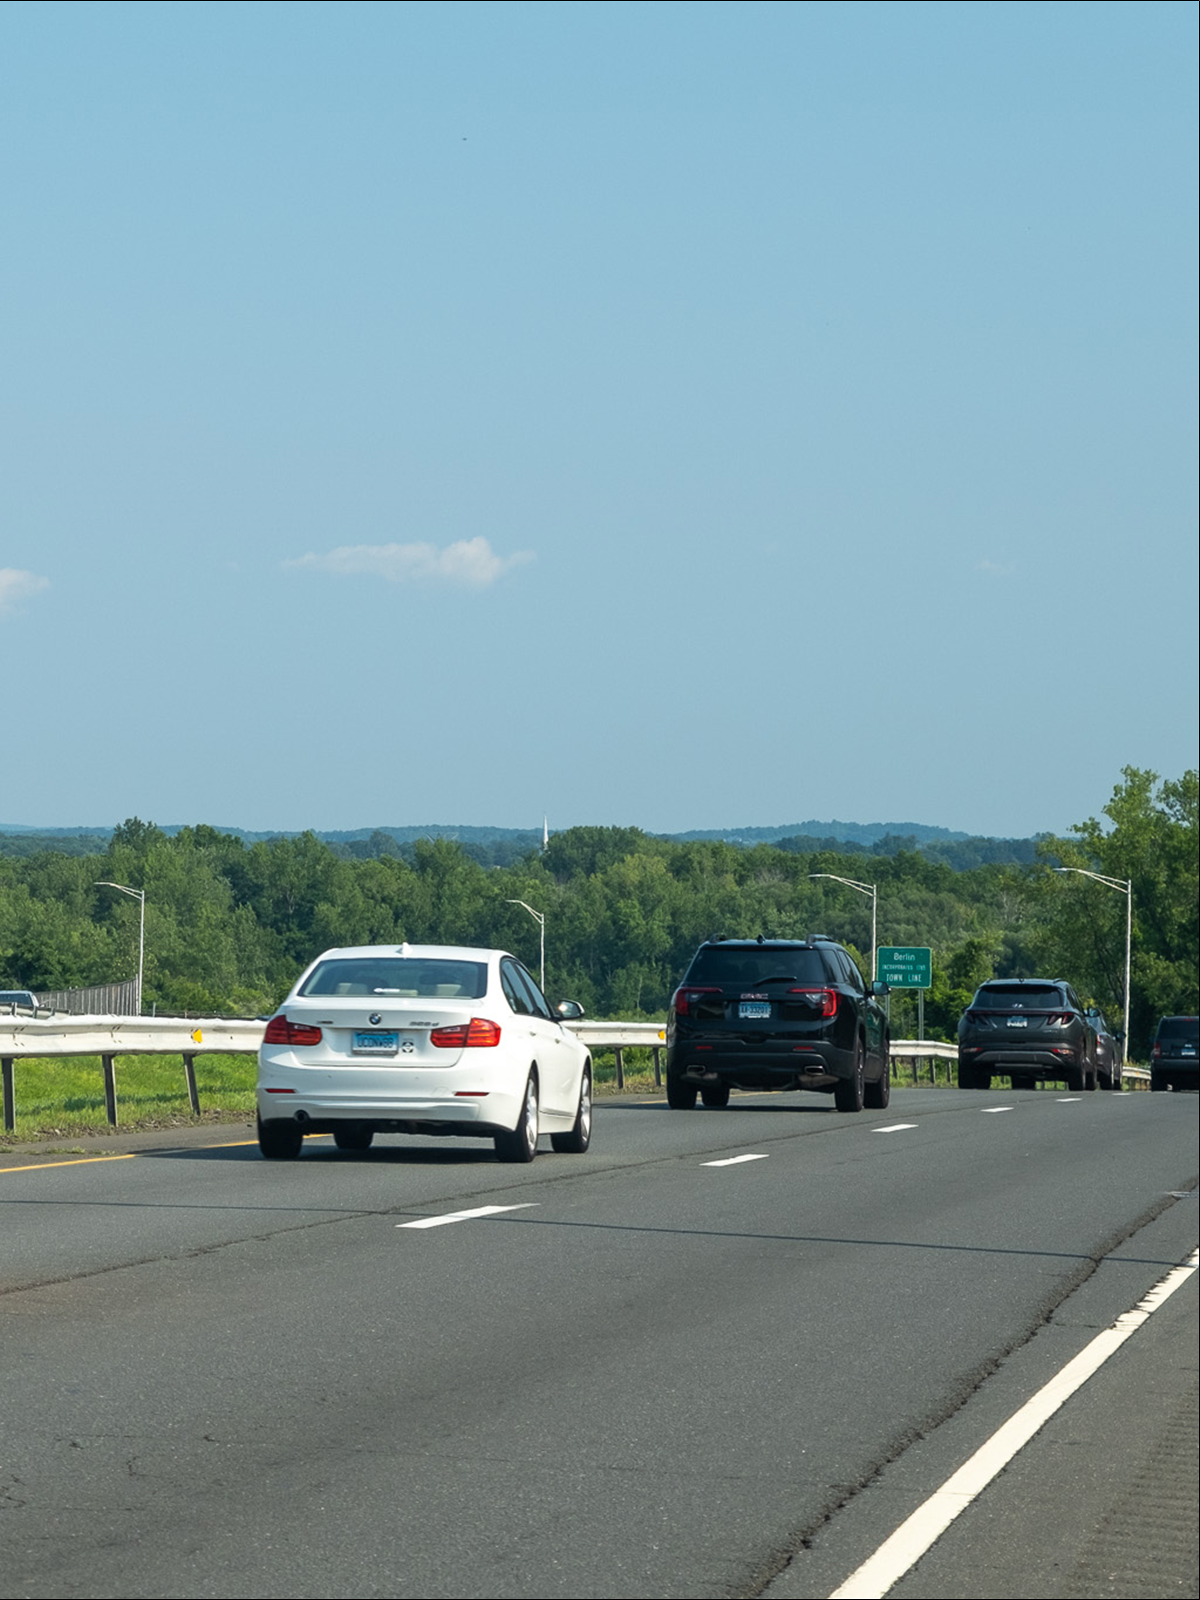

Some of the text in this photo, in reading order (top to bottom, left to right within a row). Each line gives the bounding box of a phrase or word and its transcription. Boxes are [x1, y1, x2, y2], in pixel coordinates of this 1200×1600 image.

[893, 952, 916, 961] Berlin
[886, 973, 922, 983] TOWN LINE
